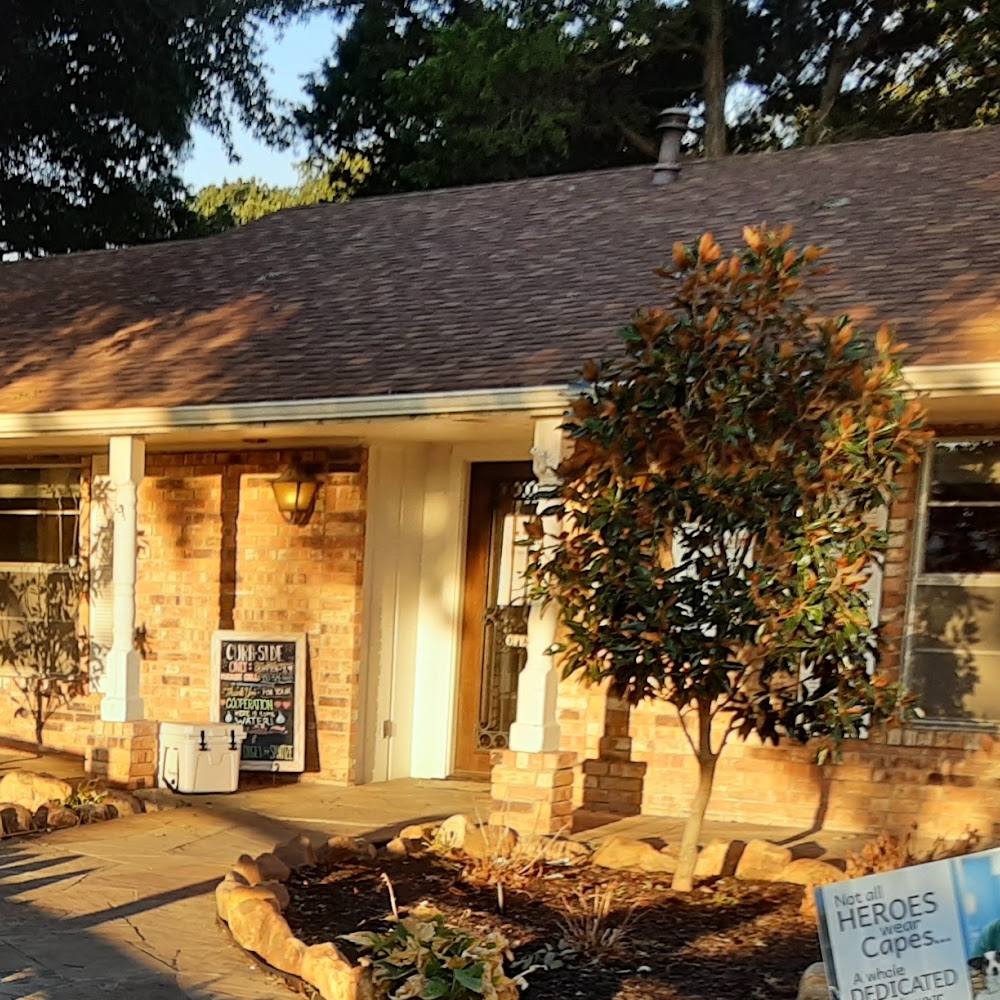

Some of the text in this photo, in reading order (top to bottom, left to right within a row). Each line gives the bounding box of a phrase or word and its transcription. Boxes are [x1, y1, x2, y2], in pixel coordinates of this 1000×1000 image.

[505, 633, 528, 648] OPE
[833, 884, 884, 907] Not all
[837, 891, 938, 932] HEROES
[879, 919, 922, 936] wear
[853, 963, 906, 985] A whole
